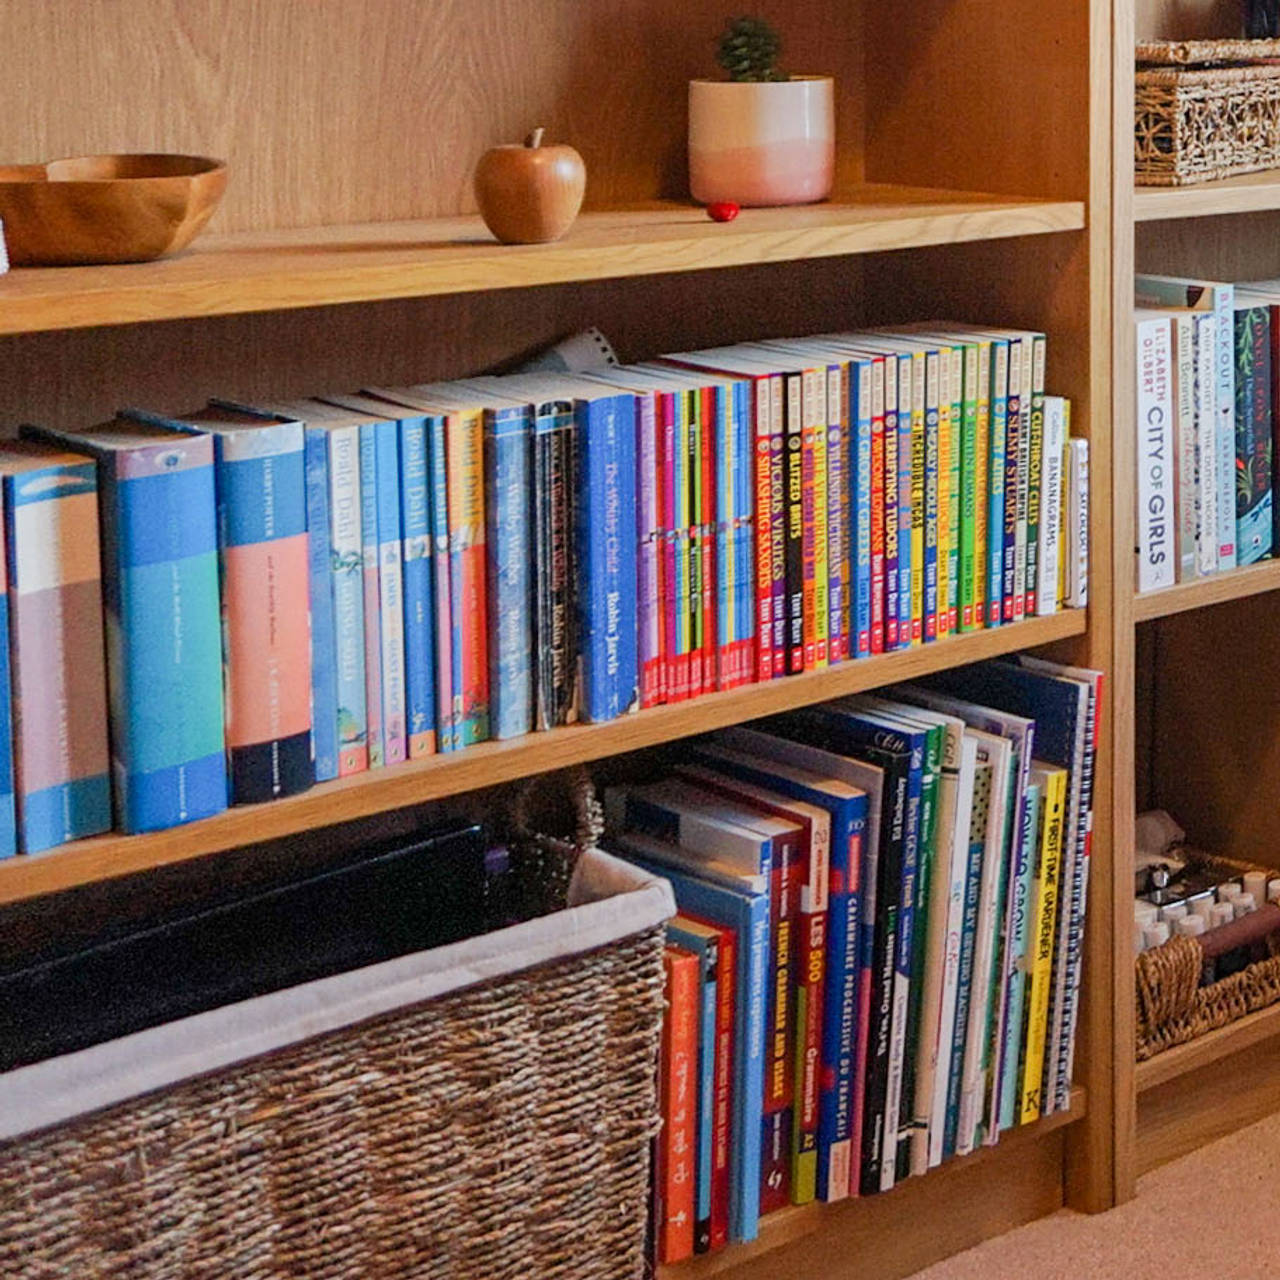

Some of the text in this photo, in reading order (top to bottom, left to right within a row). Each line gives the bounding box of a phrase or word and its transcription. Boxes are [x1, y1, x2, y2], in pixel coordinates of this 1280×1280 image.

[1154, 327, 1167, 402] ELIZABETH
[1180, 326, 1192, 417] Alan Bennett
[1219, 293, 1231, 390] BLACKOUT
[406, 427, 424, 530] Roald Dahl
[911, 429, 924, 530] INCREDIBLE INCAS
[963, 421, 974, 519] ROTTEN ROMANS
[993, 416, 1004, 455] ANGRY
[1005, 415, 1018, 534] SLIMY STUARTS
[1027, 411, 1041, 525] CUT-THROAT CELTS
[1147, 406, 1165, 566] CITY OF GIRLS
[334, 436, 353, 542] Roald Dahl
[758, 455, 770, 589] SMASHING SAXONS
[772, 455, 784, 581] VICIOUS VIKINGS
[789, 452, 801, 539] BLITZED BRITS
[828, 443, 841, 579] VILLAINOUS VICTORIANS
[858, 438, 871, 567] GROOVY GREEKS
[885, 427, 898, 560] TERRIFYING TUDORS
[1004, 545, 1015, 594] TERRY DEARY
[1026, 540, 1038, 589] TERRY DEARY
[550, 604, 564, 688] Robin Jarvis
[605, 592, 619, 676] Robin Jarvis
[891, 777, 907, 841] Ed Emberley
[903, 797, 919, 909] Revise GCSE French
[810, 915, 823, 948] LES
[1037, 817, 1060, 960] FIRST-TIME GARDENER
[808, 950, 821, 983] 500
[953, 853, 983, 1048] ME AND MY SEWING MACHINE
[772, 922, 789, 1099] FRENCH GRAMMAR AND USAGE
[834, 898, 858, 1140] GRAMMAIRE PROGRESSIVE DU FRANÇAIS
[803, 1047, 817, 1124] Grammaire
